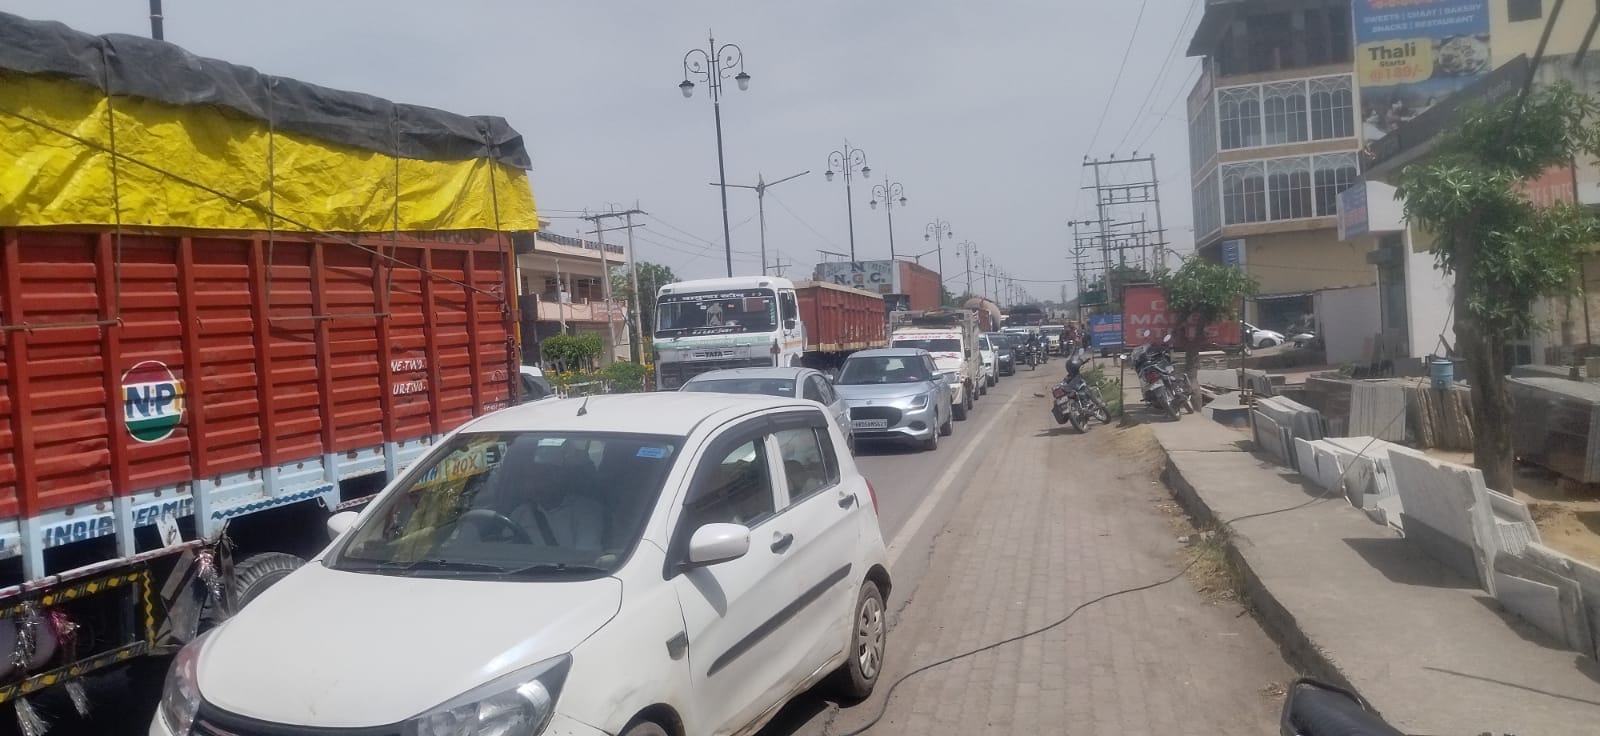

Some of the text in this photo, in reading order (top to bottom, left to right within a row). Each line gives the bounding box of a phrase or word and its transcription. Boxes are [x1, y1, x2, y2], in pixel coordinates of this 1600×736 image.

[1363, 14, 1400, 23] SWEETS
[1444, 4, 1481, 15] BAKERY
[1371, 15, 1474, 33] SNACKS RESTAURANT
[1367, 42, 1416, 61] Thali
[42, 515, 114, 549] INDIA
